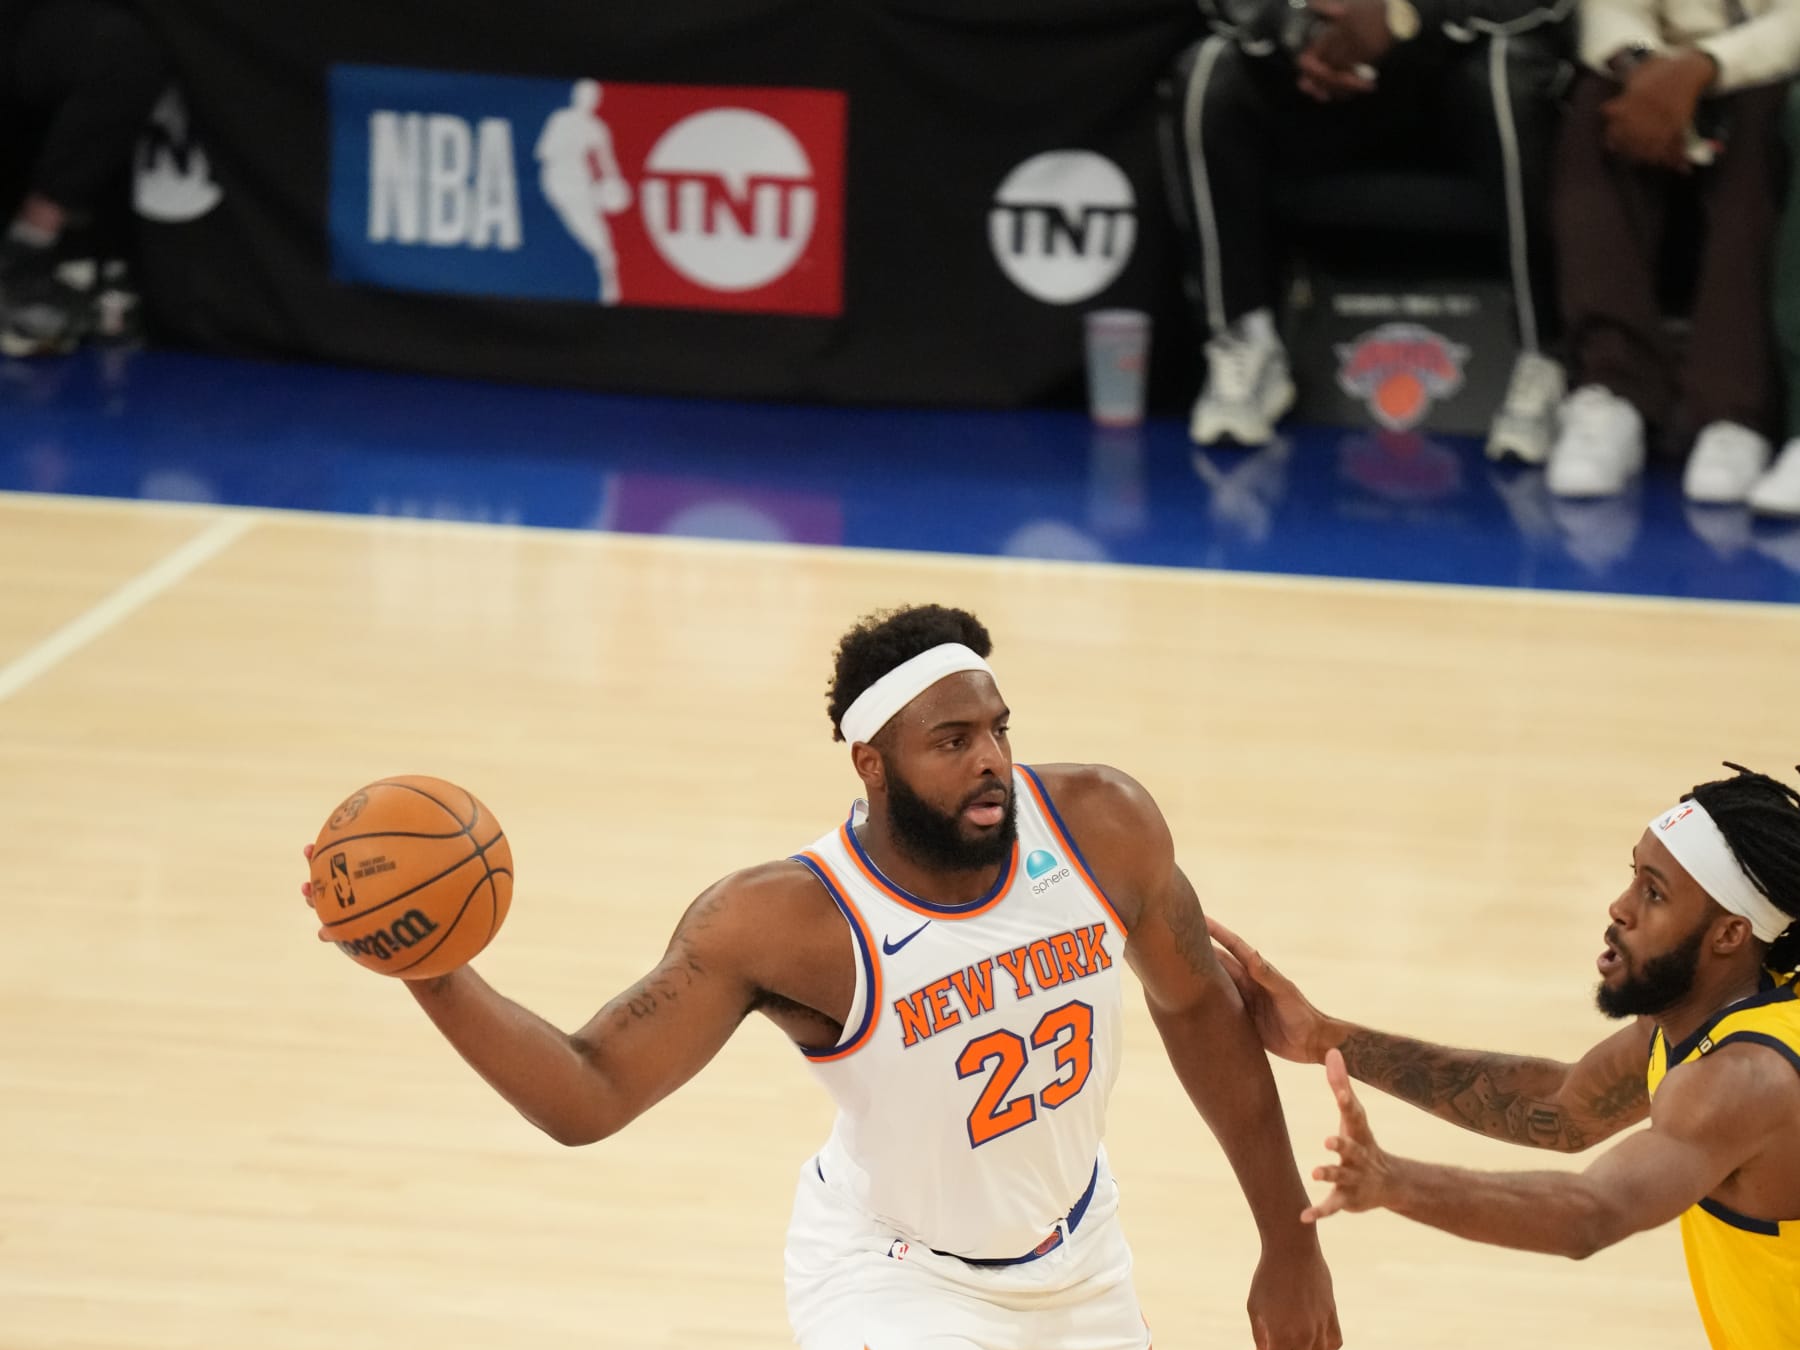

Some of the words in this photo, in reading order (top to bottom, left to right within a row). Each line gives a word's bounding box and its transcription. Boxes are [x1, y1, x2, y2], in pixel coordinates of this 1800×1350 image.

[367, 109, 522, 251] NBA
[1031, 866, 1071, 895] sphere
[894, 959, 996, 1048] NEW
[997, 922, 1112, 999] YORK
[955, 999, 1094, 1149] 23
